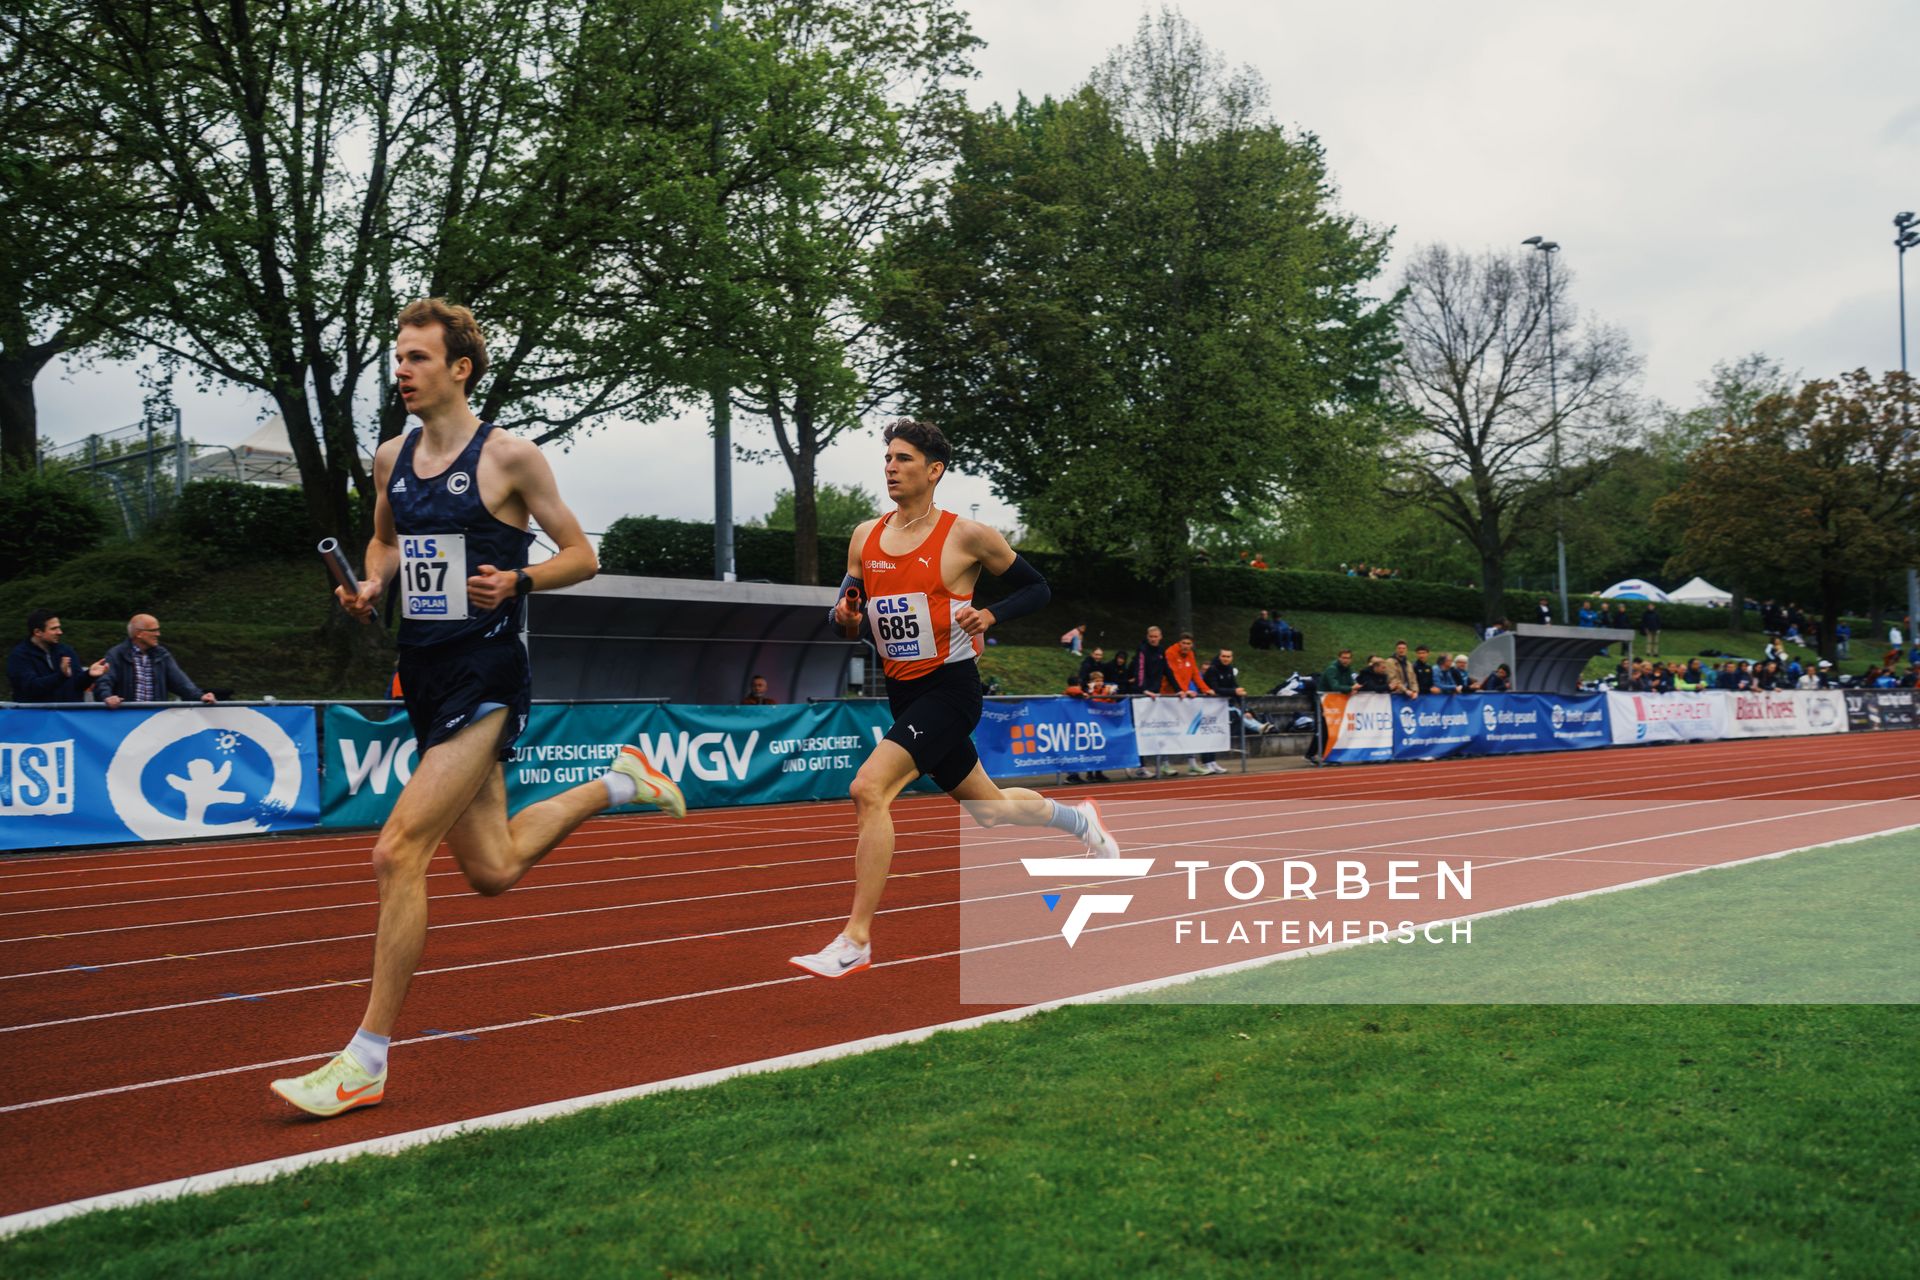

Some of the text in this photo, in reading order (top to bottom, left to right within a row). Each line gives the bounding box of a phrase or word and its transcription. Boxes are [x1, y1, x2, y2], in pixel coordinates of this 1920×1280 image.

[871, 560, 897, 570] Brillux
[405, 561, 448, 592] 167
[422, 598, 445, 609] PLAN
[877, 614, 920, 640] 685
[897, 643, 918, 653] PLAN
[769, 739, 796, 754] GUT
[797, 735, 862, 752] VERSICHERT.
[508, 746, 533, 762] UT
[639, 730, 760, 783] WGV
[782, 755, 853, 773] UND GUT IST.
[520, 768, 551, 784] UND
[554, 766, 585, 783] GUT
